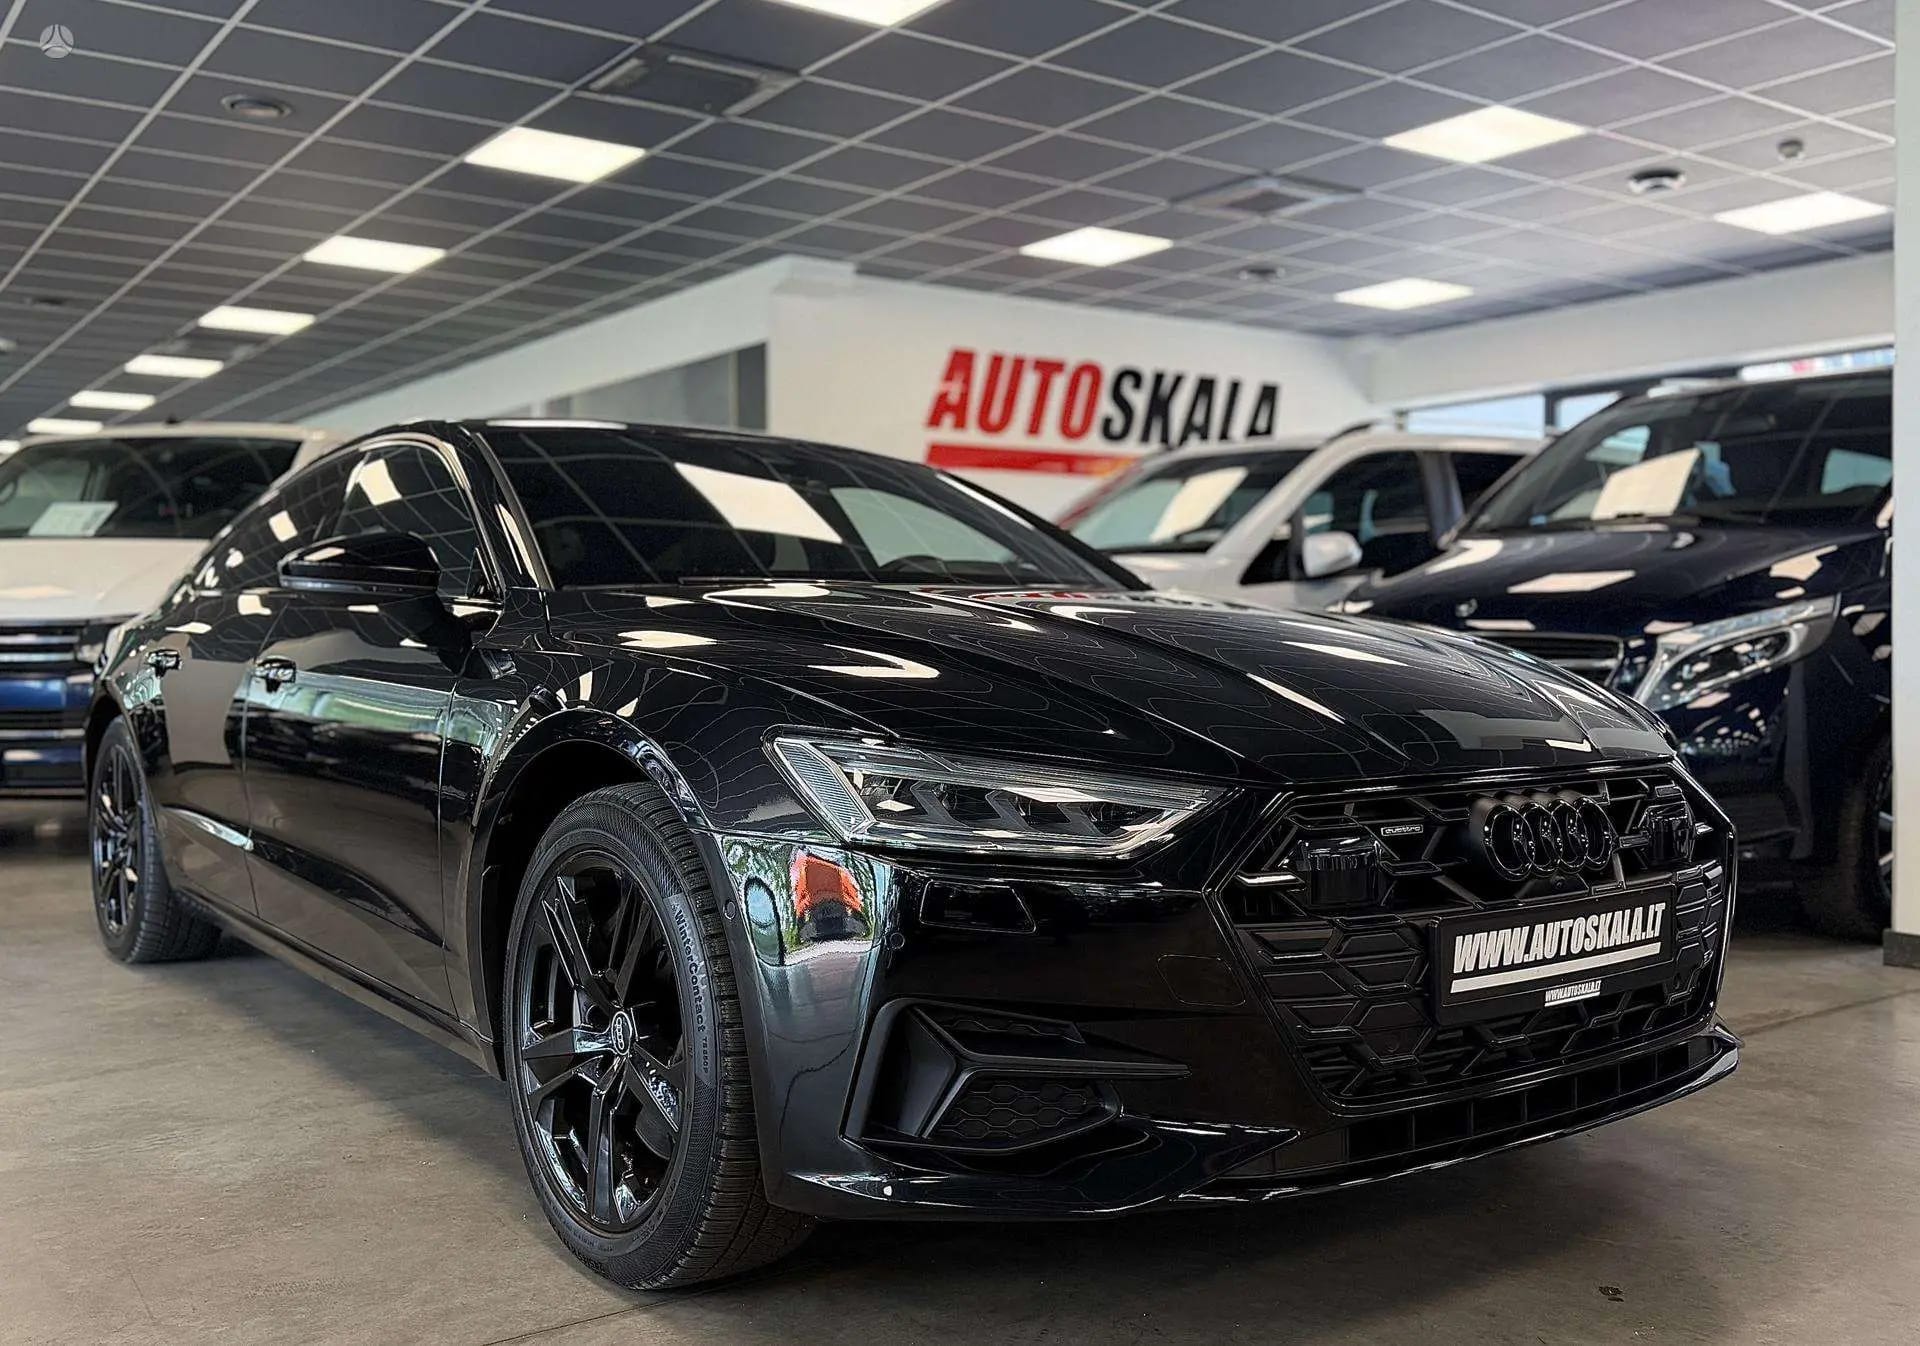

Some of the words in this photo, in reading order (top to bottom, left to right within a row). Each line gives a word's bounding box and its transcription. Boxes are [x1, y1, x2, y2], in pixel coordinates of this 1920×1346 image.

[926, 348, 1280, 446] AUTOSKALA
[674, 909, 706, 1032] WinterContact
[1453, 902, 1666, 973] WWW.AUTOSKALA.LT
